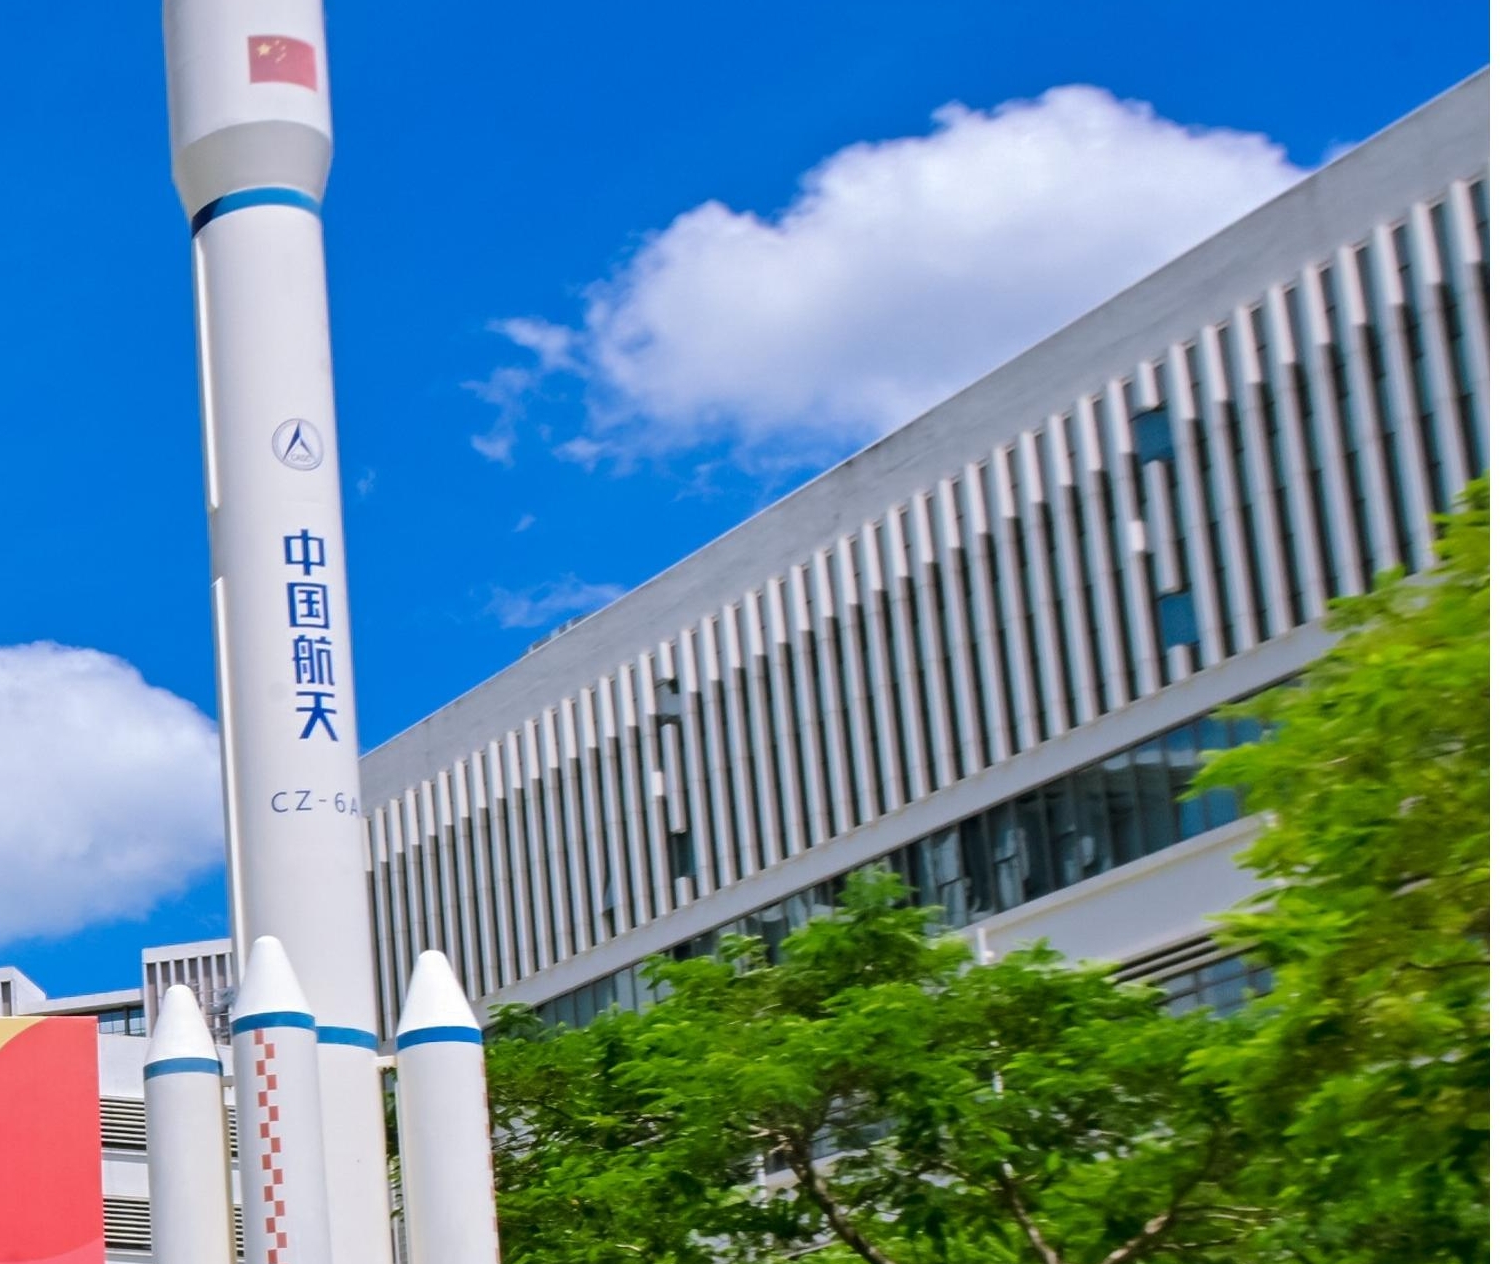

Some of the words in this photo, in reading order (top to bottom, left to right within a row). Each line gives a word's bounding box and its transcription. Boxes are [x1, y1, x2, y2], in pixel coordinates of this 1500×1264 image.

[284, 529, 338, 741] 中国航天
[271, 789, 358, 815] CZ-6A
